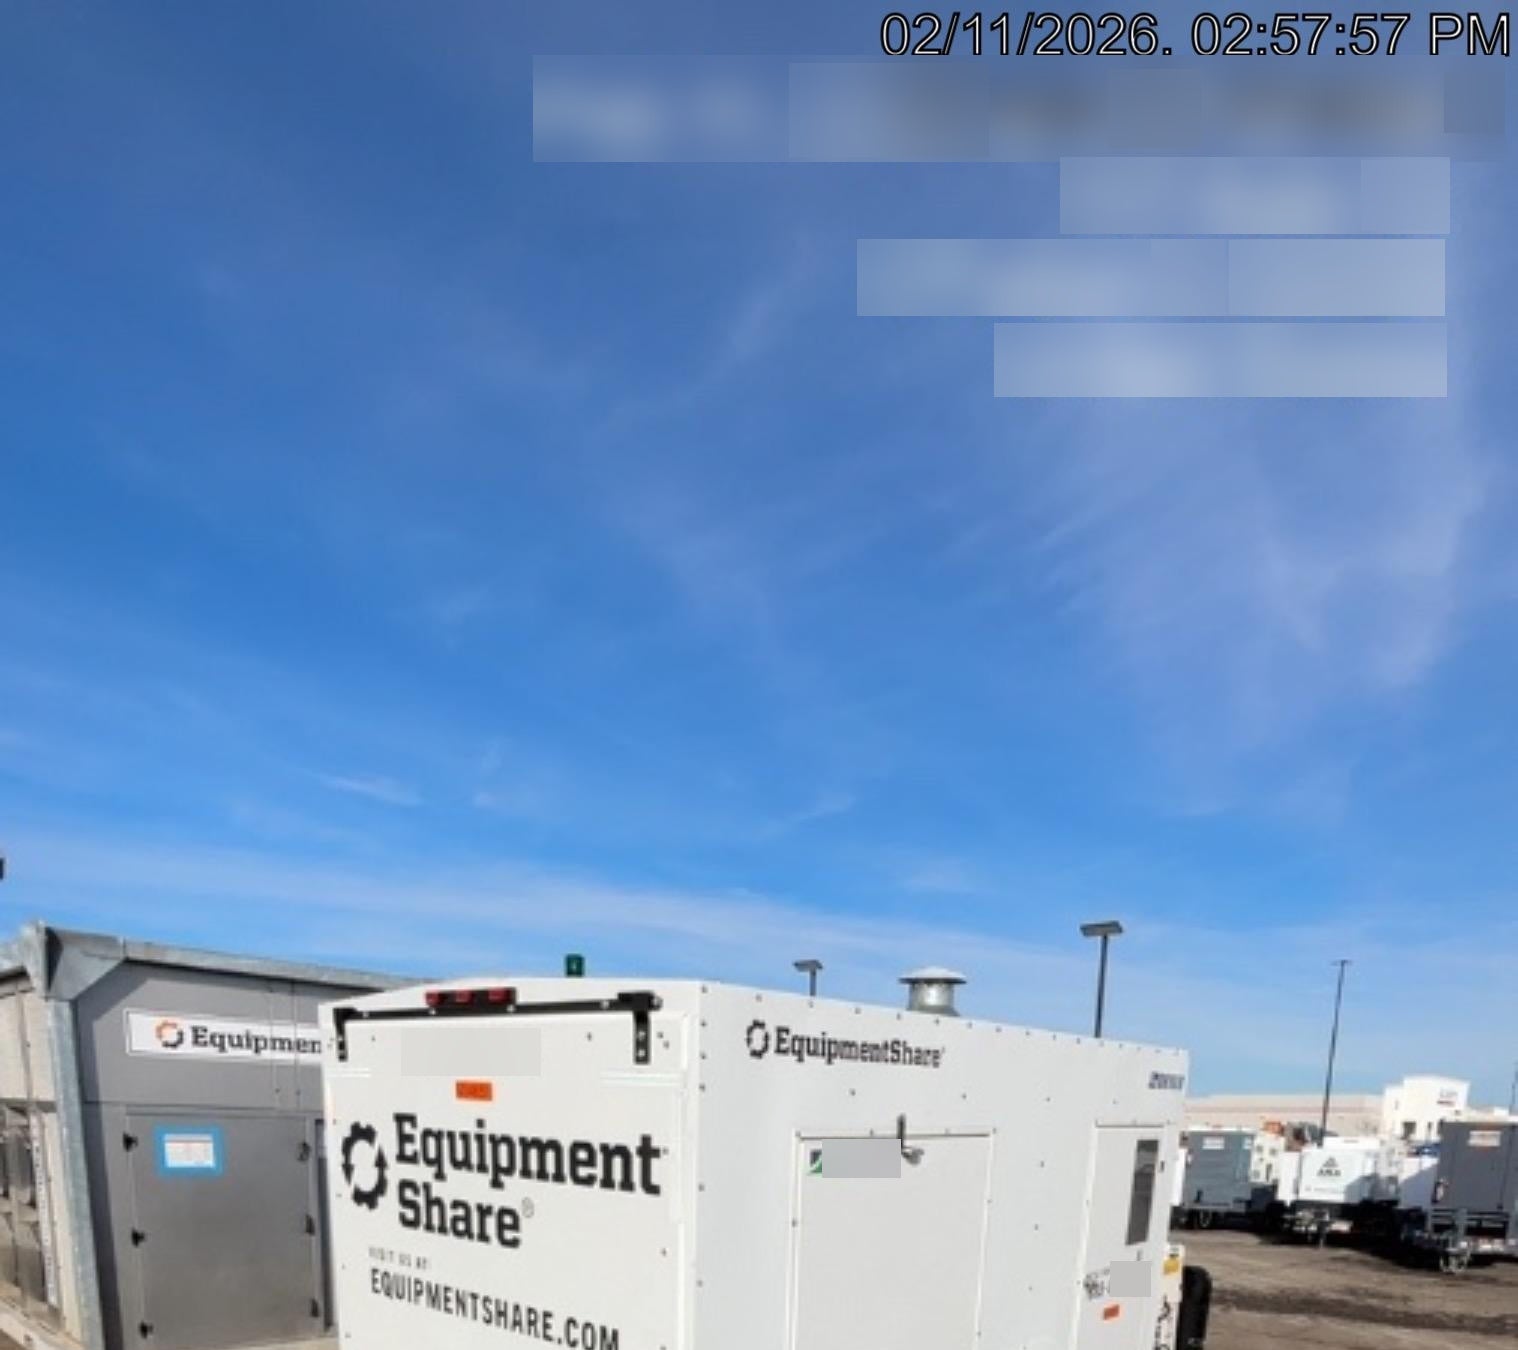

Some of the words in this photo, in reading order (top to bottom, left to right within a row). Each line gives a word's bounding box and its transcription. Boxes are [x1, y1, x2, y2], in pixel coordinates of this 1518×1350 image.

[774, 1025, 942, 1068] EquipmentShare
[394, 1113, 661, 1195] Equipment
[397, 1179, 522, 1249] Share
